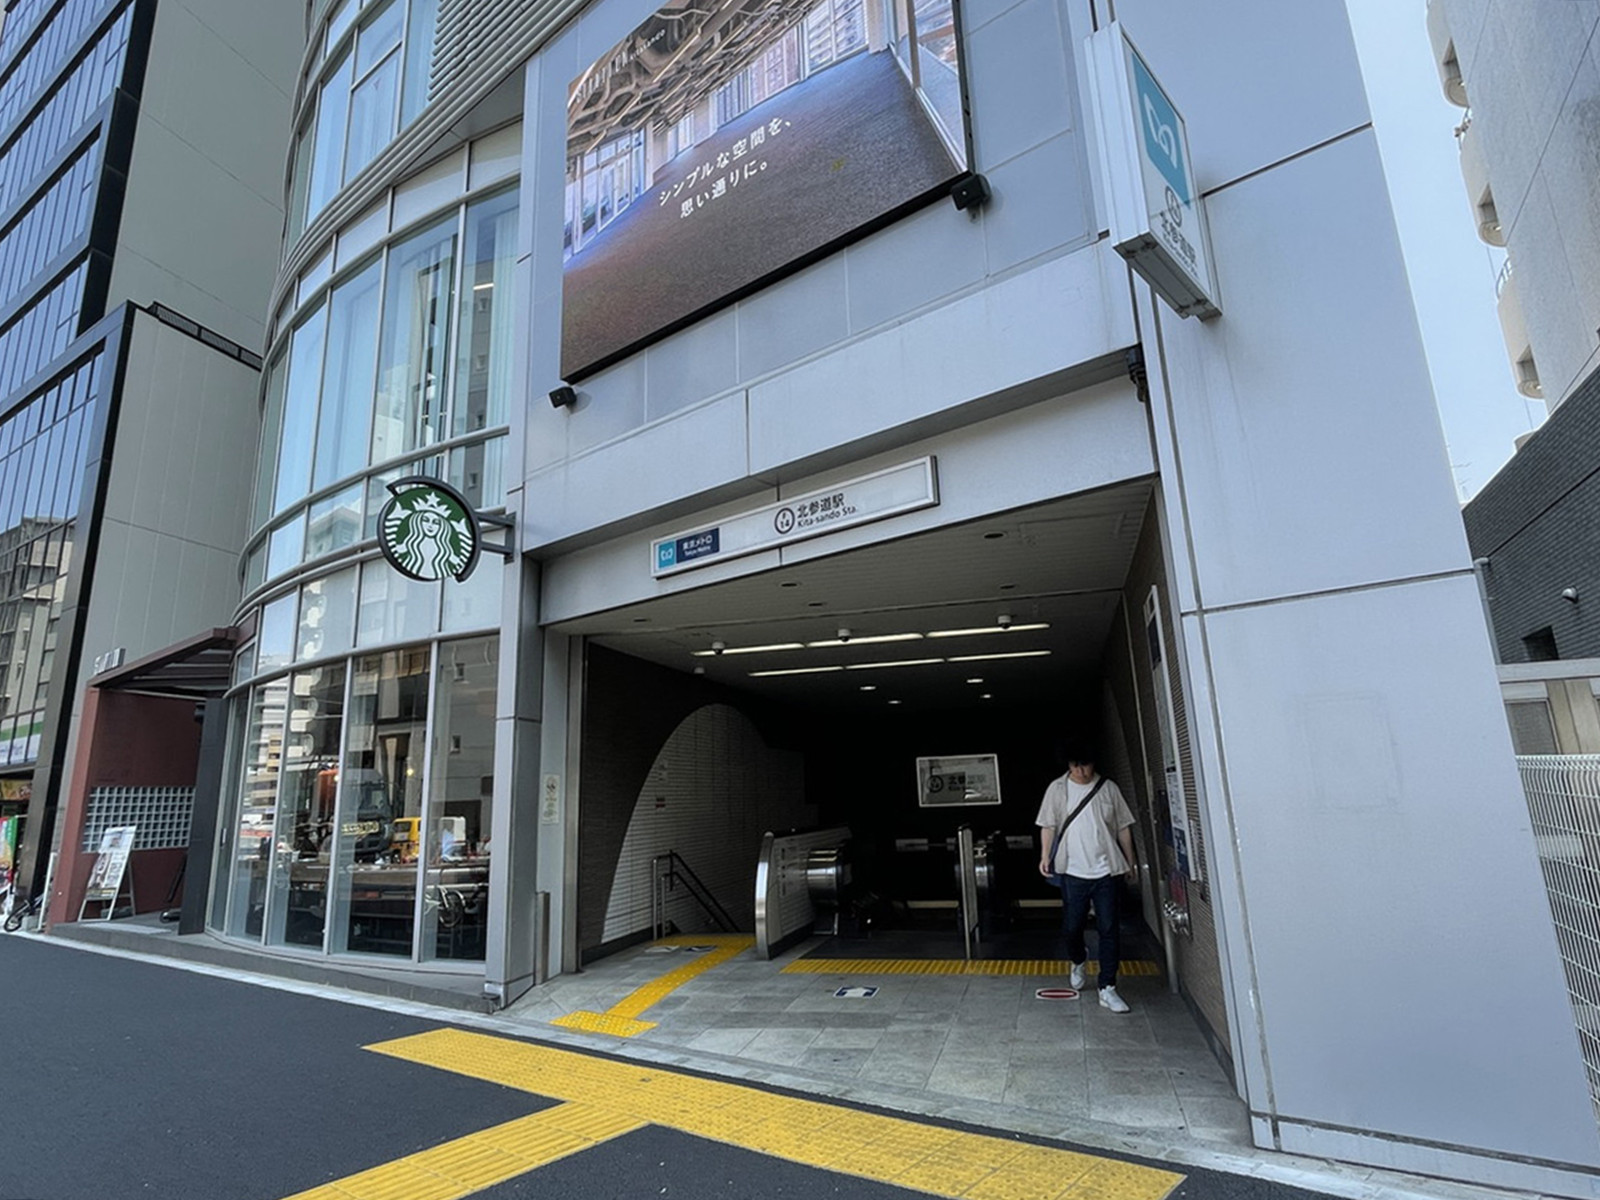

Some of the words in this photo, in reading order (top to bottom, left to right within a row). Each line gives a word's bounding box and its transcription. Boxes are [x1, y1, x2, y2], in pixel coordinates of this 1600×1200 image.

[660, 117, 792, 207] シンプルな空間を、
[680, 160, 768, 219] 思い通りに。
[797, 493, 845, 519] 北参道駅
[798, 510, 841, 528] Kita-sando
